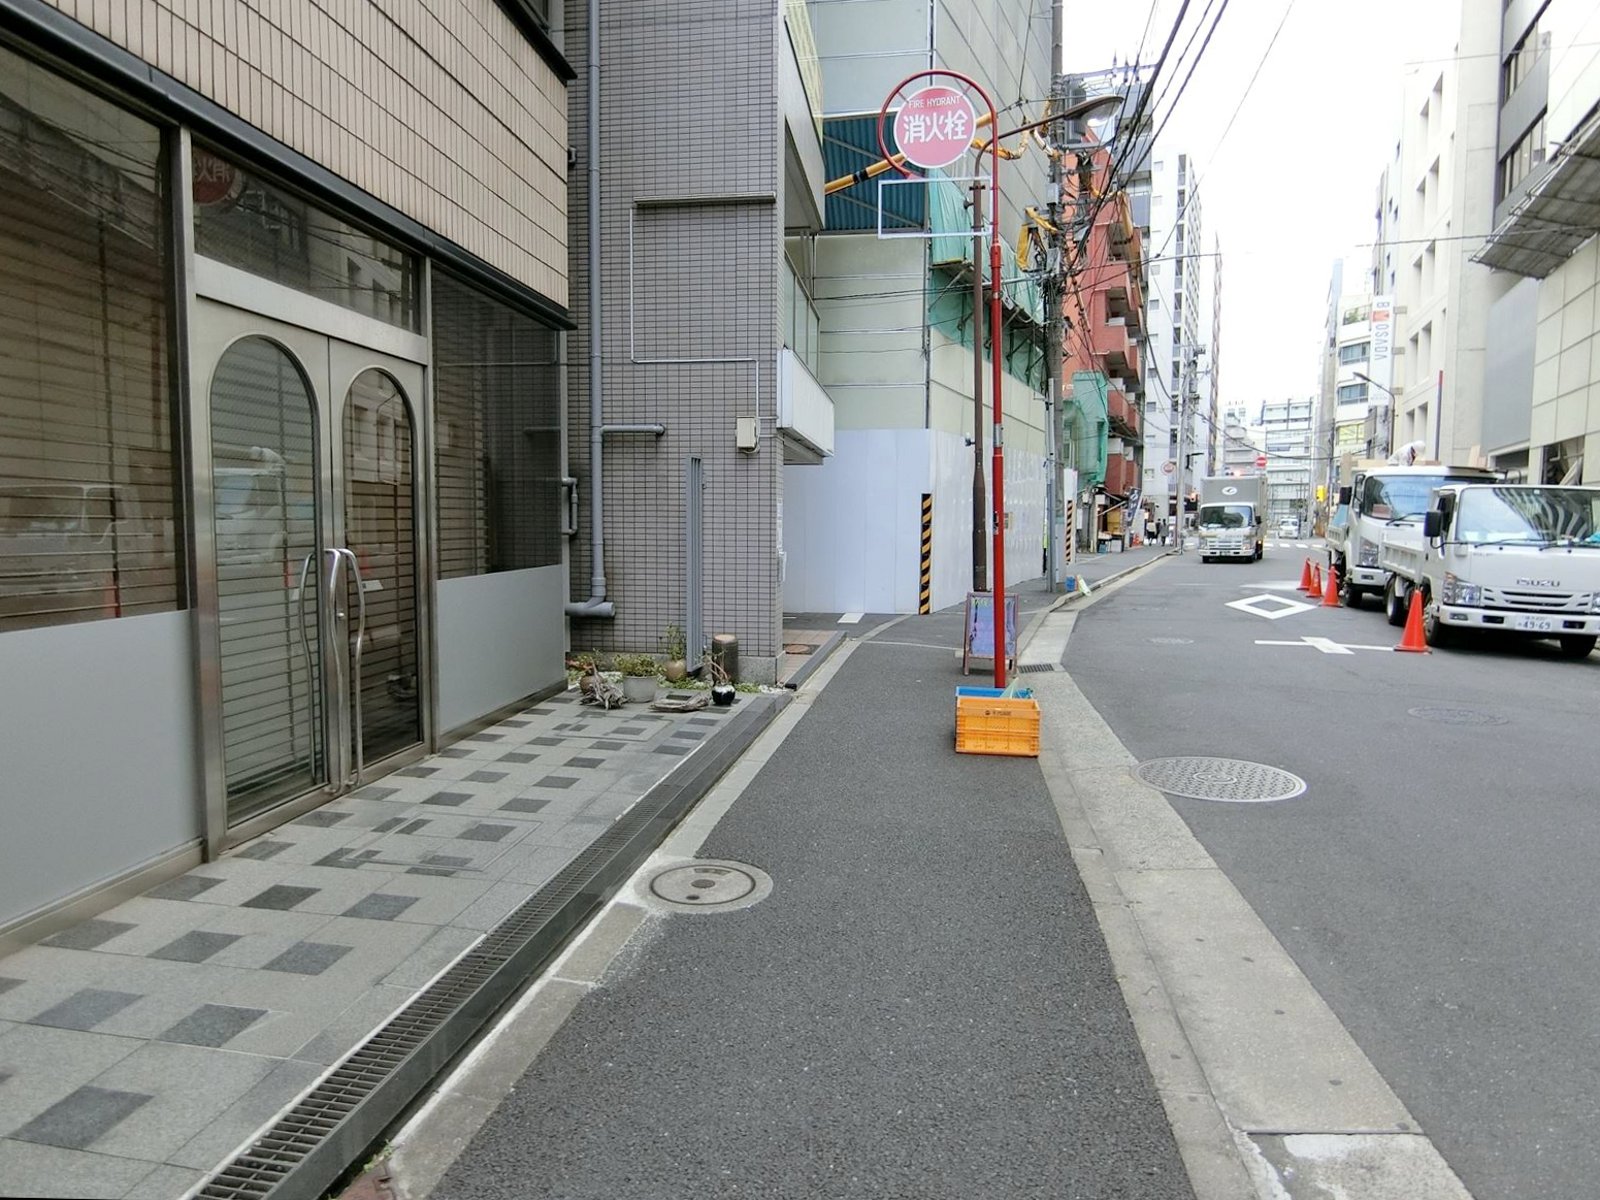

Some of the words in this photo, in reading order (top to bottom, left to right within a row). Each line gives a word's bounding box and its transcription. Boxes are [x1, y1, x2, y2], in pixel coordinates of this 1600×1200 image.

[909, 98, 924, 108] FIRE
[927, 96, 961, 107] HYDRANT
[903, 110, 968, 144] 消火栓
[1516, 578, 1560, 587] ISUZU
